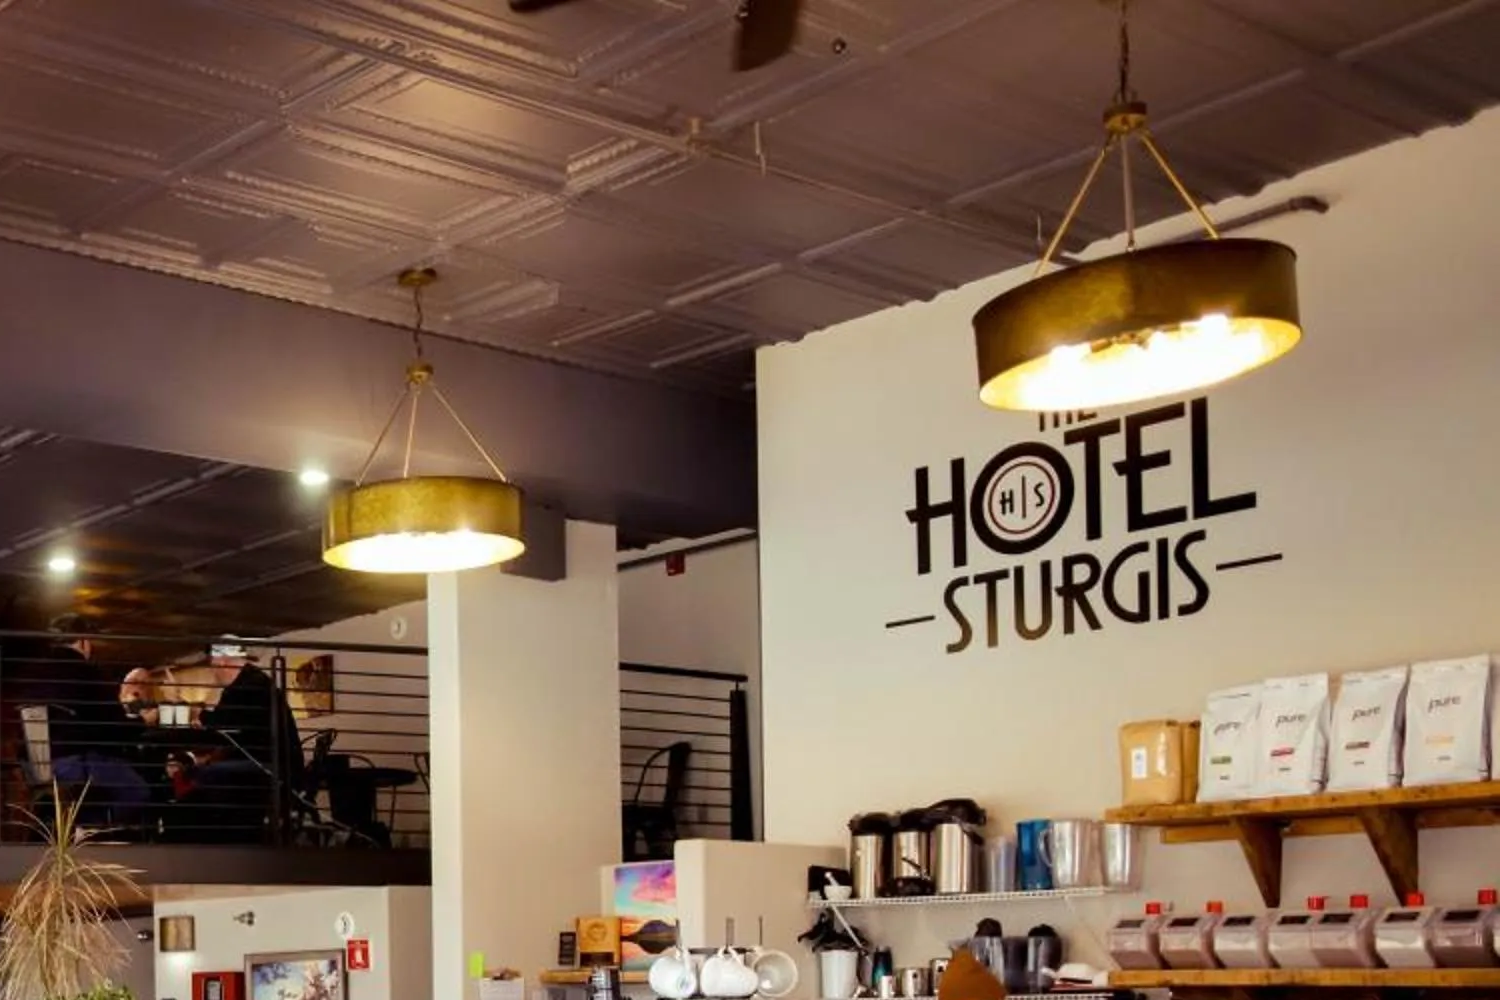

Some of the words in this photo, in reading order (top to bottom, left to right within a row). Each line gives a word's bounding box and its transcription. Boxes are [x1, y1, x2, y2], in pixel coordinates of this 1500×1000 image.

[905, 397, 1257, 577] HOTEL
[943, 529, 1210, 654] STURGIS
[1427, 696, 1461, 713] pure
